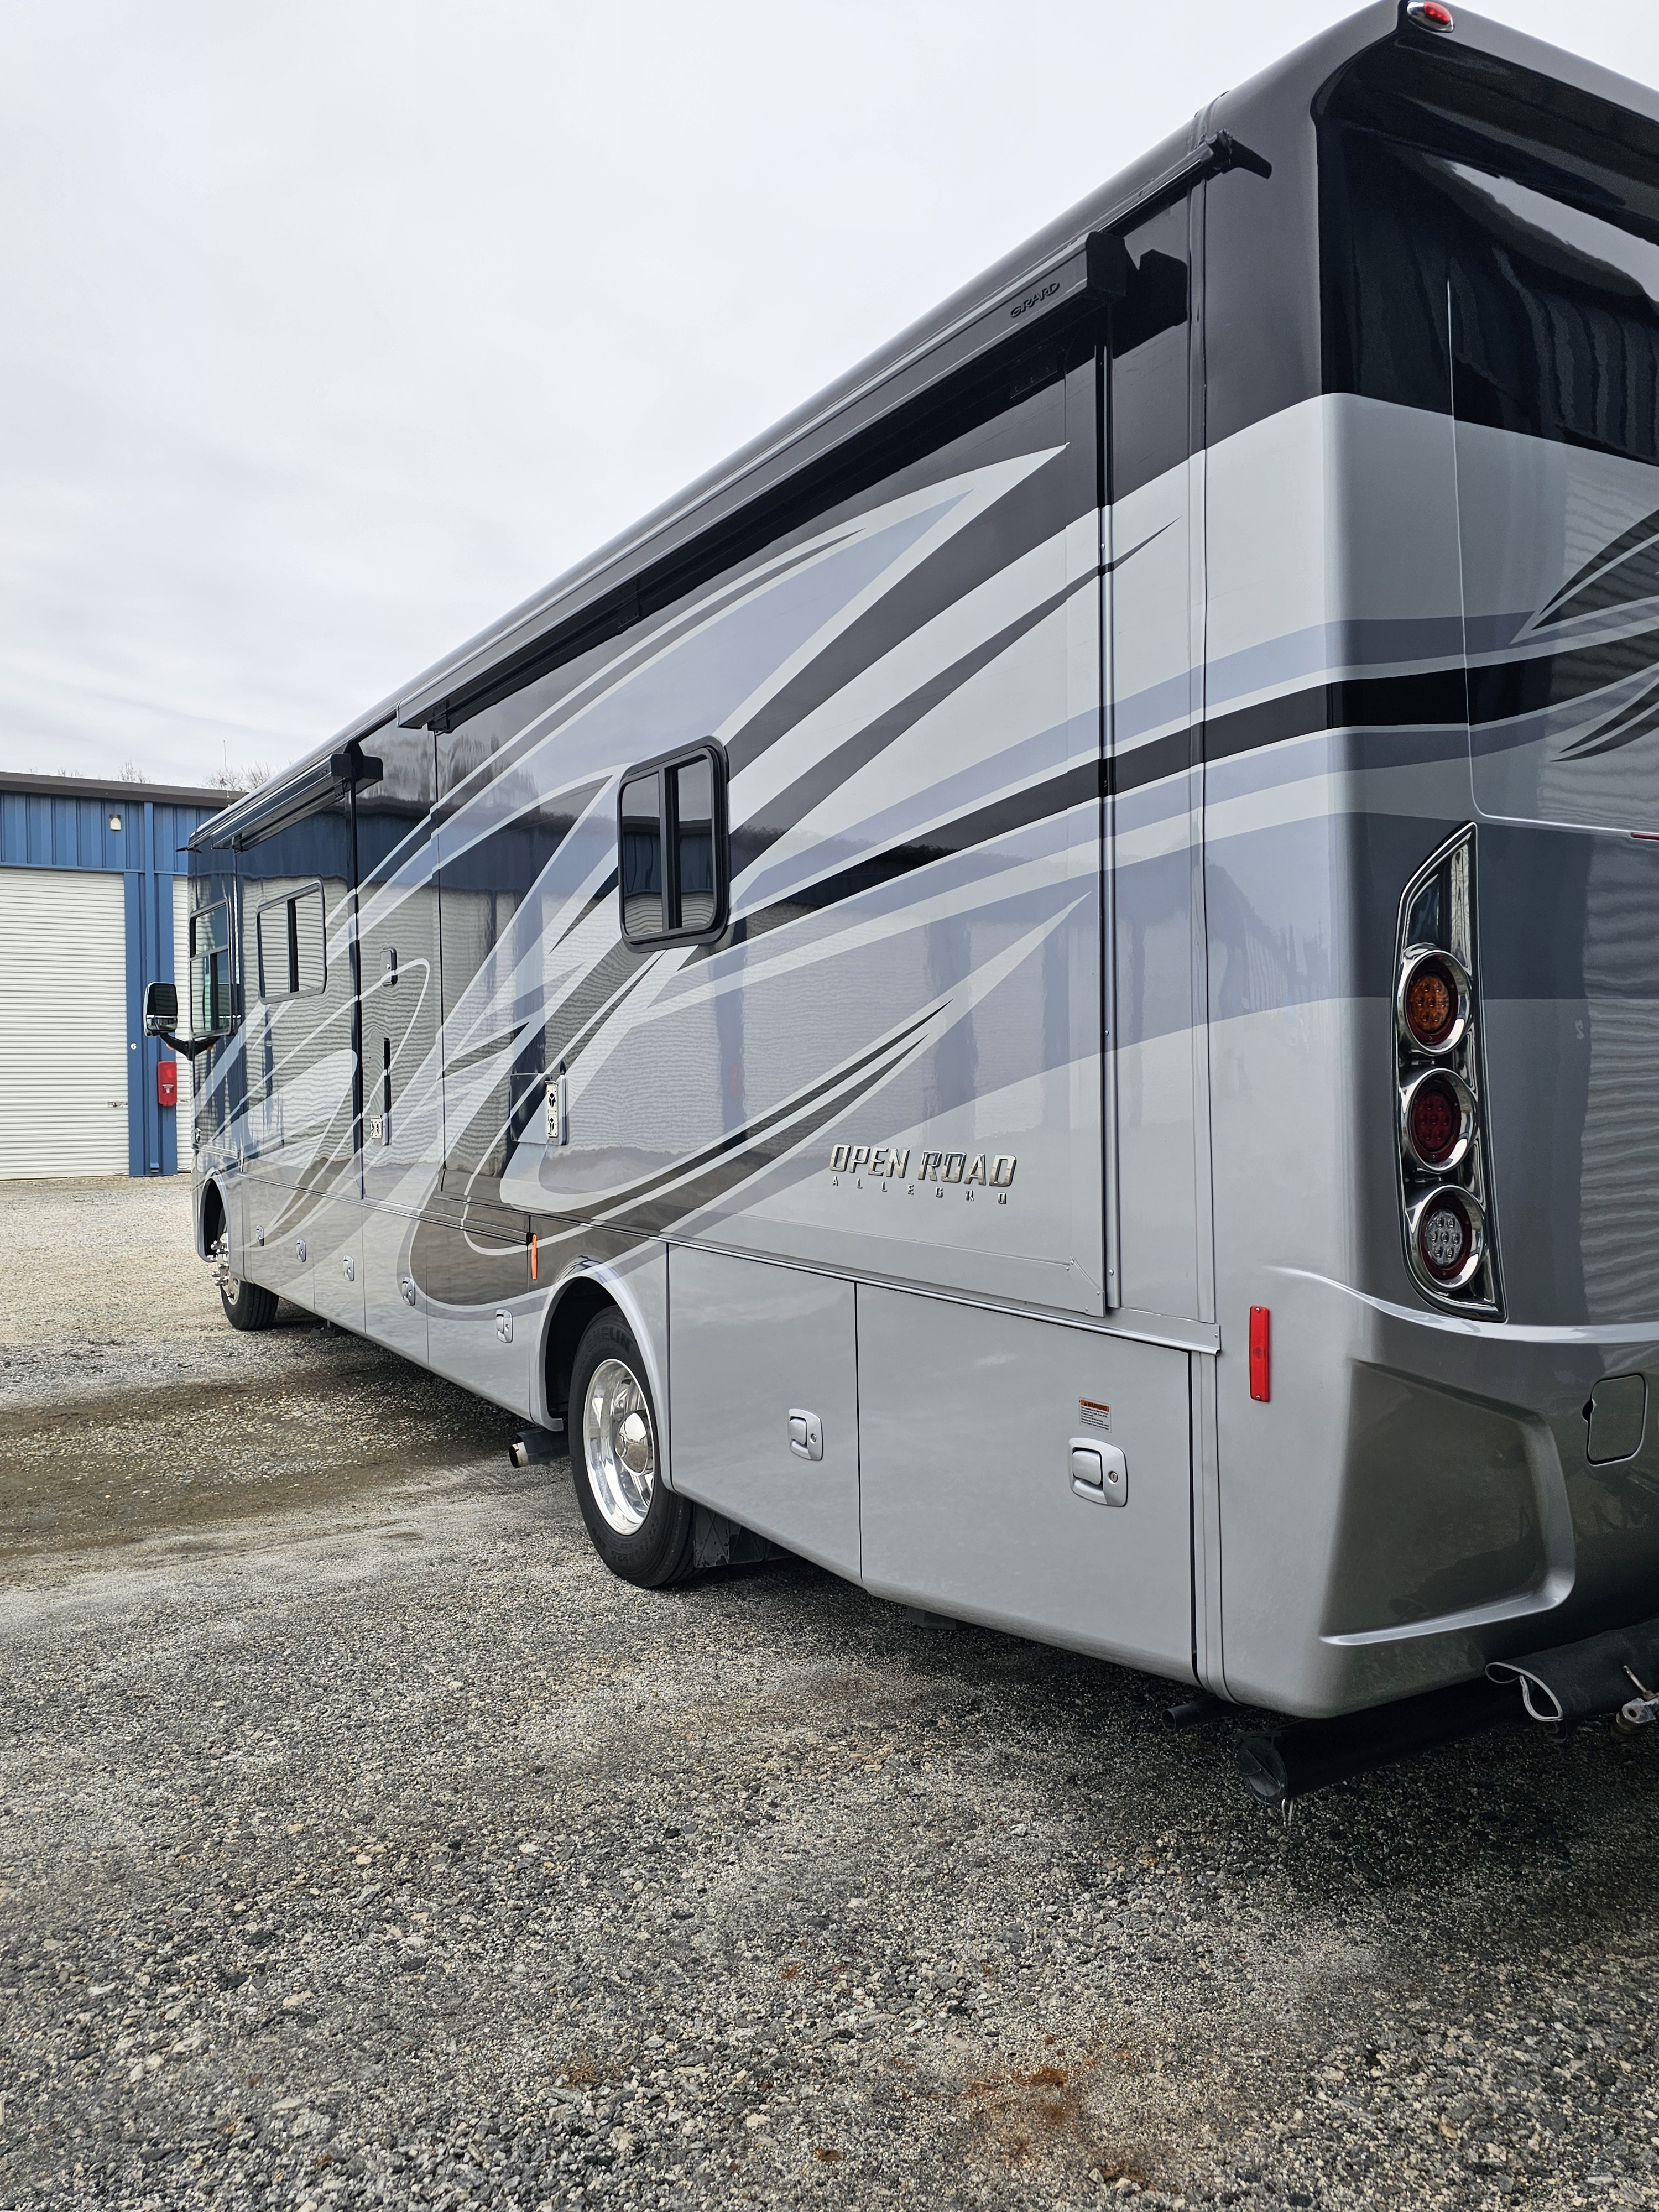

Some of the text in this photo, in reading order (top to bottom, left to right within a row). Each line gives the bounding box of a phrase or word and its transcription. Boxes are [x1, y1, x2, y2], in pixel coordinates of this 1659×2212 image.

[830, 1144, 1017, 1187] OPEN ROAD
[832, 1176, 1006, 1204] ALLEGRO
